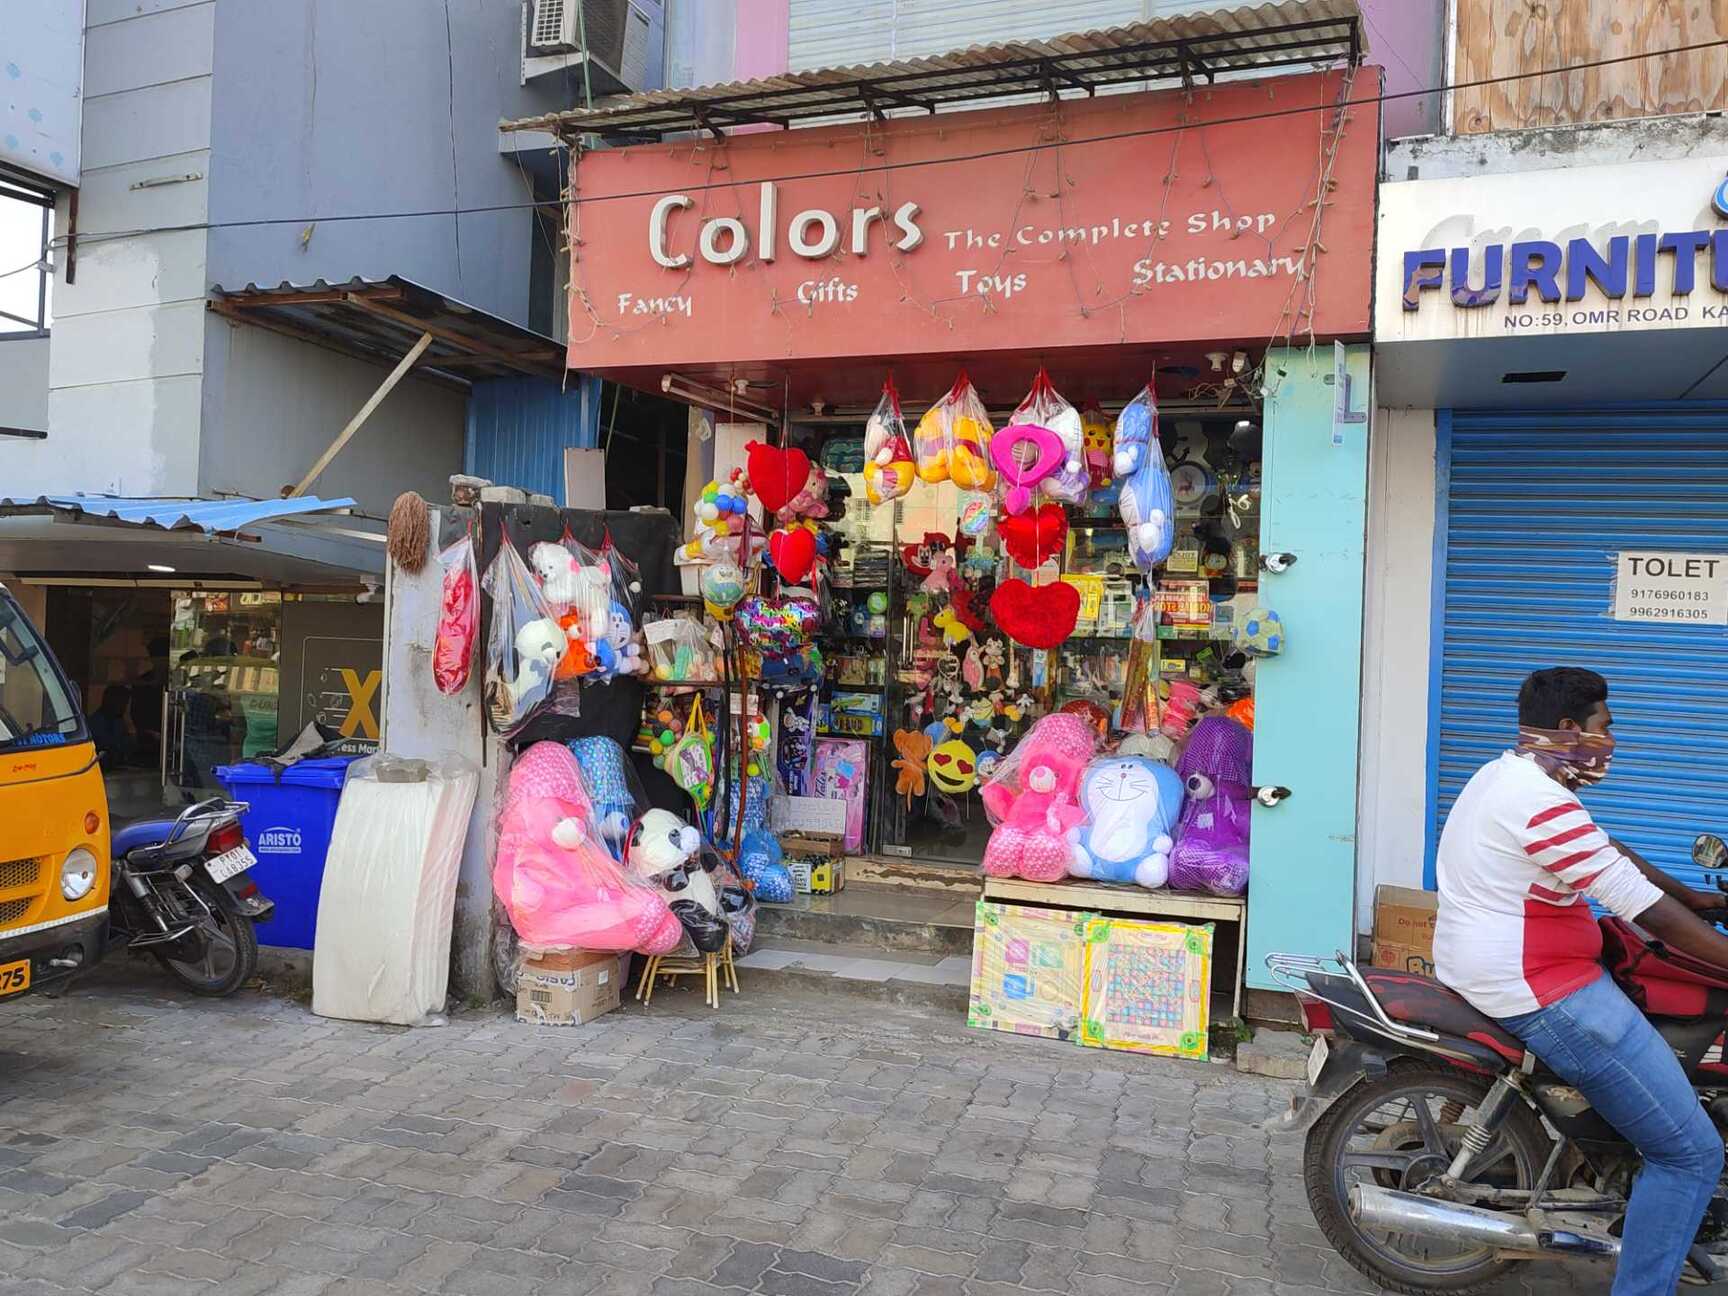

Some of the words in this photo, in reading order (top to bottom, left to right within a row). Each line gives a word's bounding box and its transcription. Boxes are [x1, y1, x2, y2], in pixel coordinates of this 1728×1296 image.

[648, 181, 926, 270] Colors
[944, 230, 1001, 250] The
[1016, 217, 1171, 246] Complete
[1187, 209, 1277, 234] Shop
[617, 292, 693, 316] Fancy
[796, 276, 859, 304] Gifts
[954, 268, 1028, 299] Toys
[1132, 255, 1305, 285] Stationary
[1627, 306, 1689, 323] ROAD
[1627, 557, 1720, 578] TOLET
[1631, 588, 1709, 601] 9176960183
[1630, 606, 1708, 619] 9962916305
[258, 832, 302, 846] ARISTO
